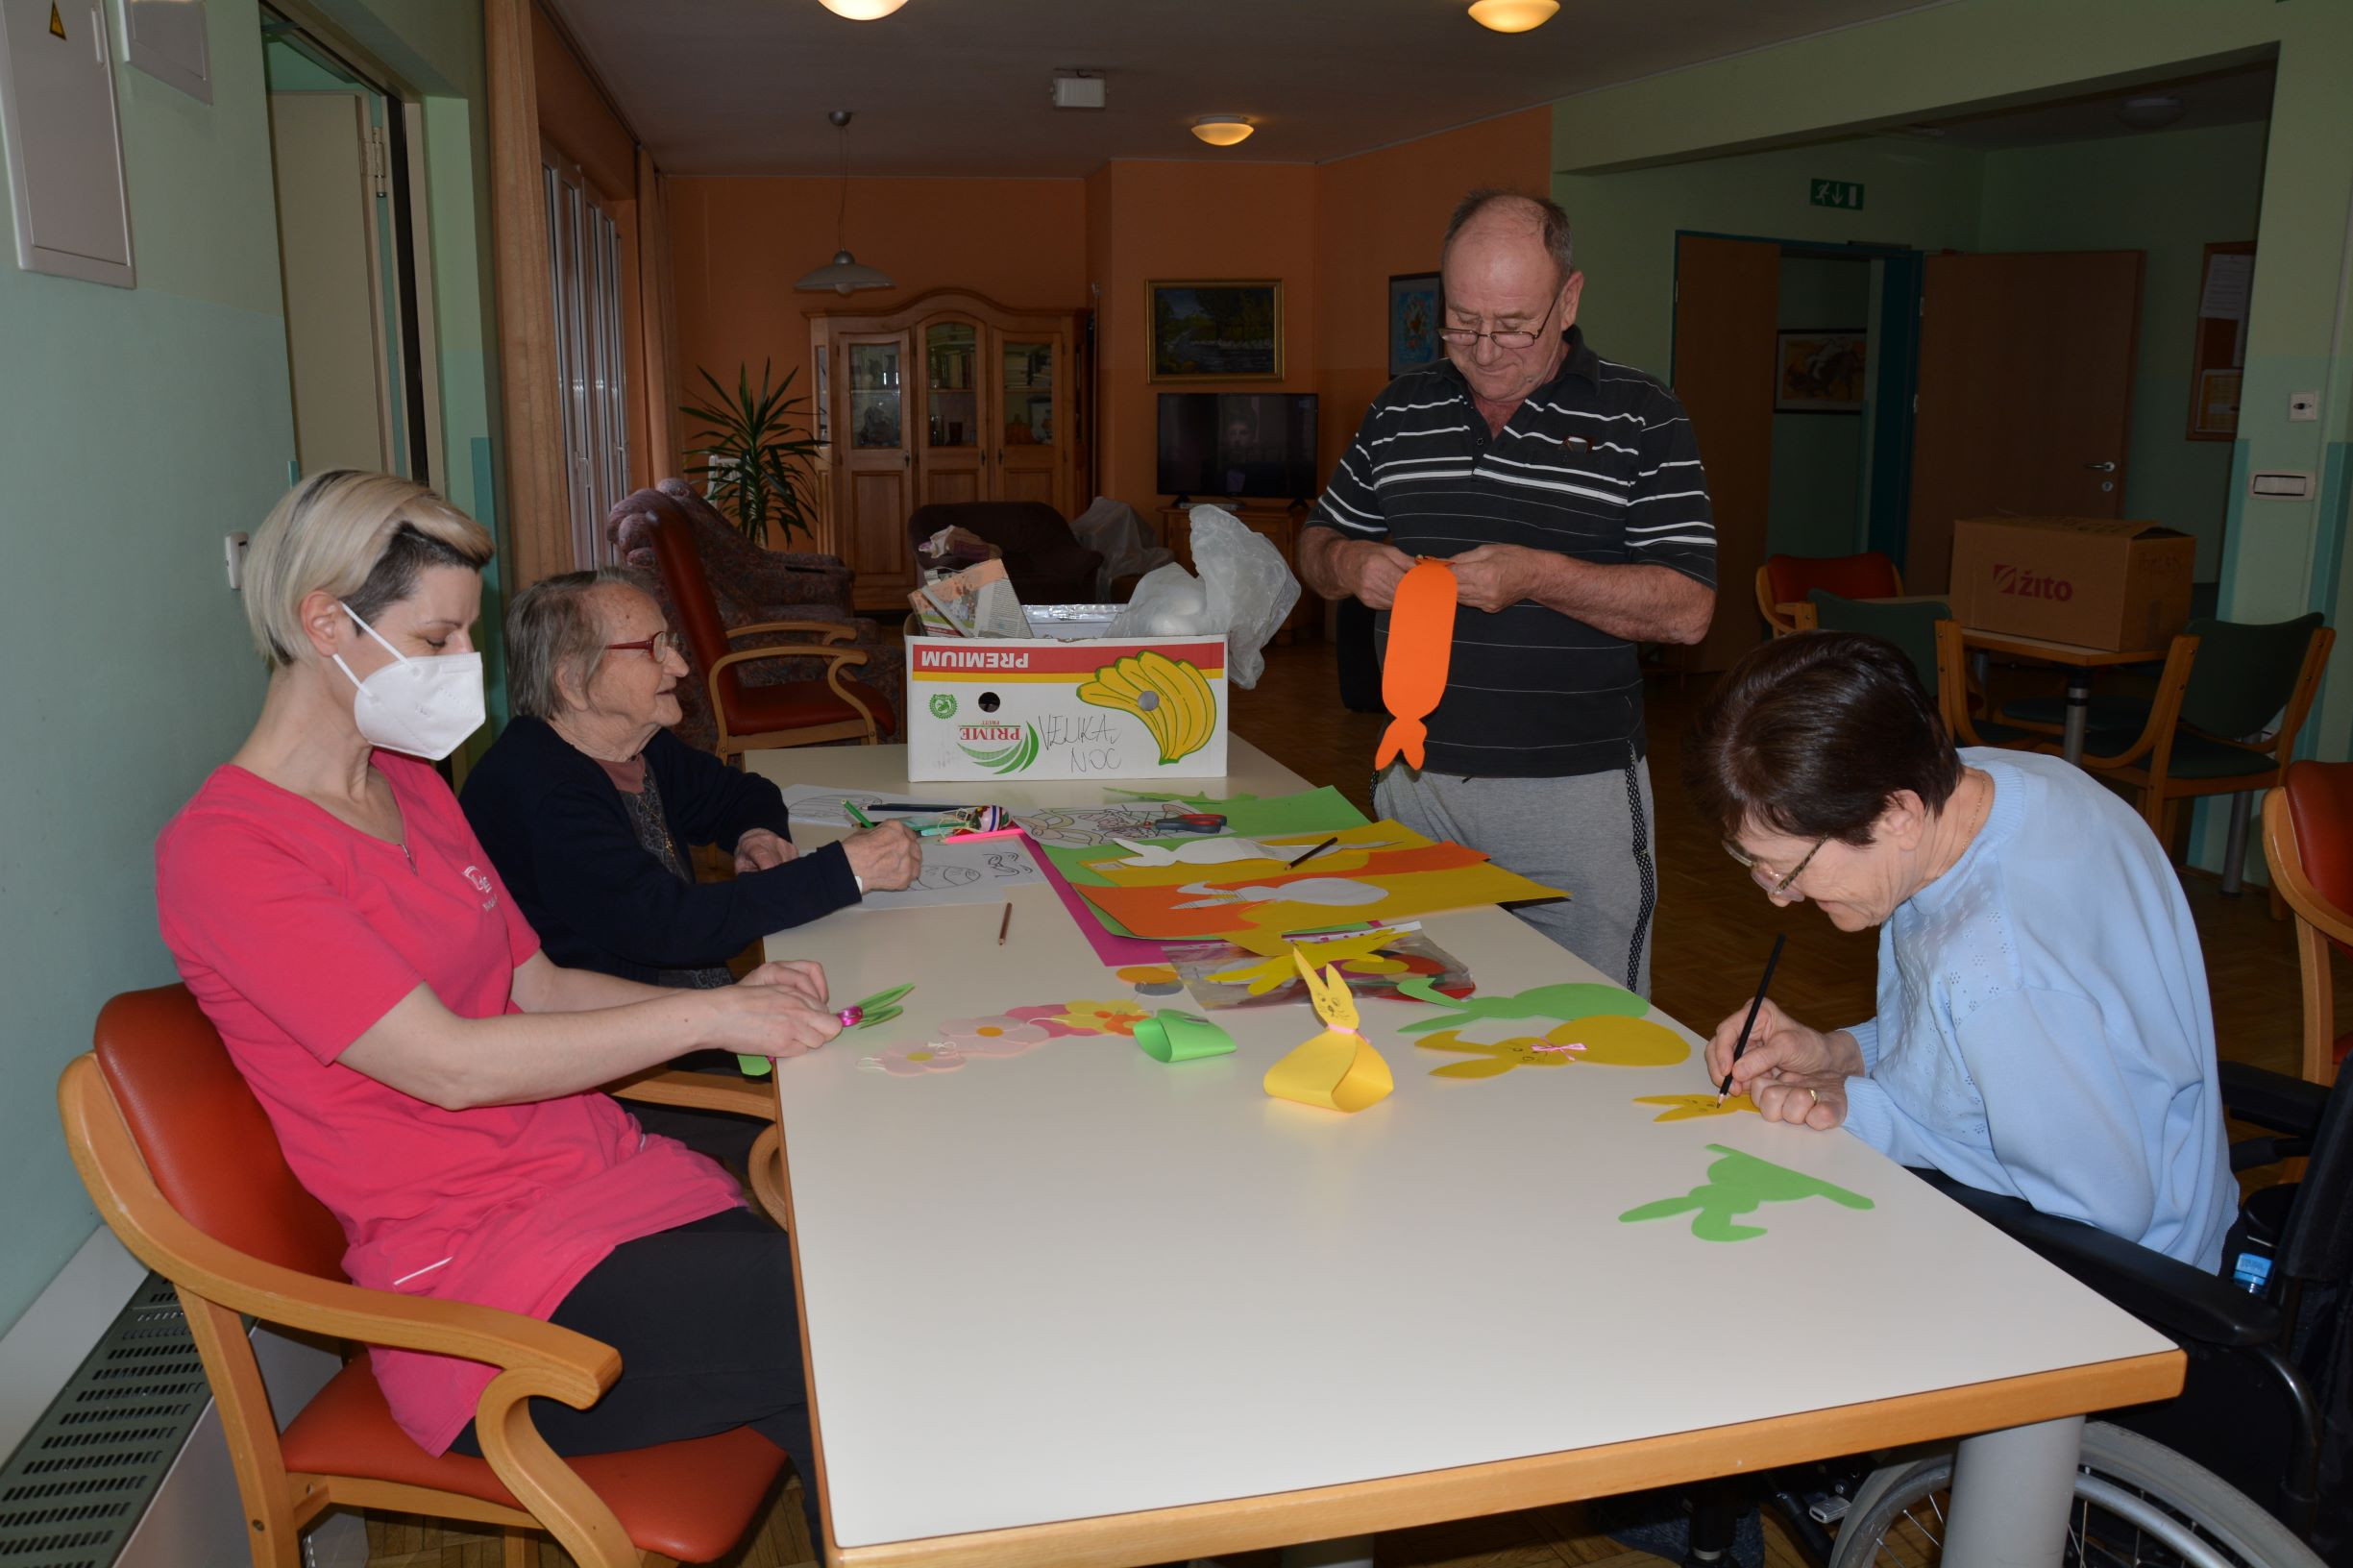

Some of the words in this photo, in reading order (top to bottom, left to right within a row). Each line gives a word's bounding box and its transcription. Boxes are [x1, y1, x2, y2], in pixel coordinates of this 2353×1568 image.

[2019, 570, 2073, 601] žito
[921, 650, 1029, 669] PREMIUM
[959, 727, 1021, 741] PRIME
[1038, 714, 1116, 751] VELIKA
